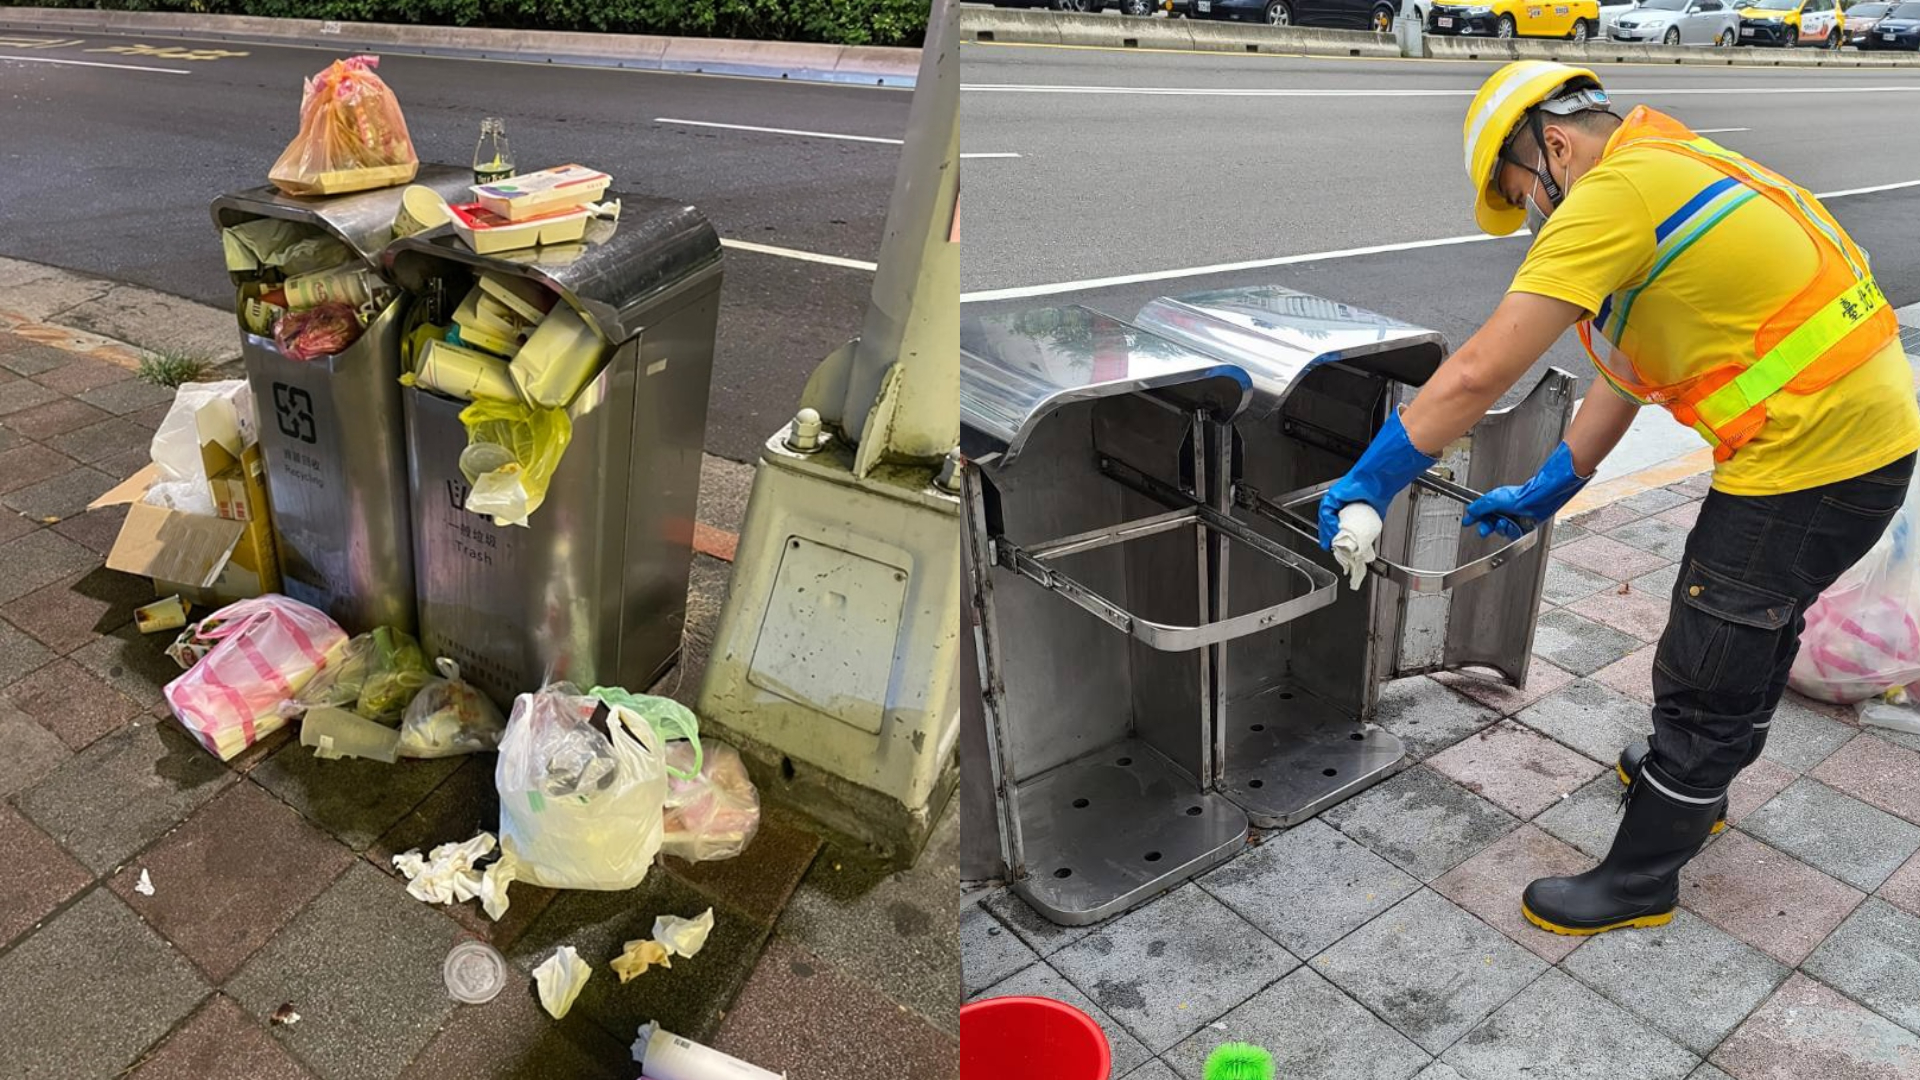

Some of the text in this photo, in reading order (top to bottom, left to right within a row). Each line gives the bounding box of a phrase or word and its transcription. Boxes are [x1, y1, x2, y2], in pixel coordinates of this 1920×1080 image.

[284, 464, 324, 489] Recycling
[448, 522, 497, 549] 一般垃圾
[455, 540, 492, 566] Trash
